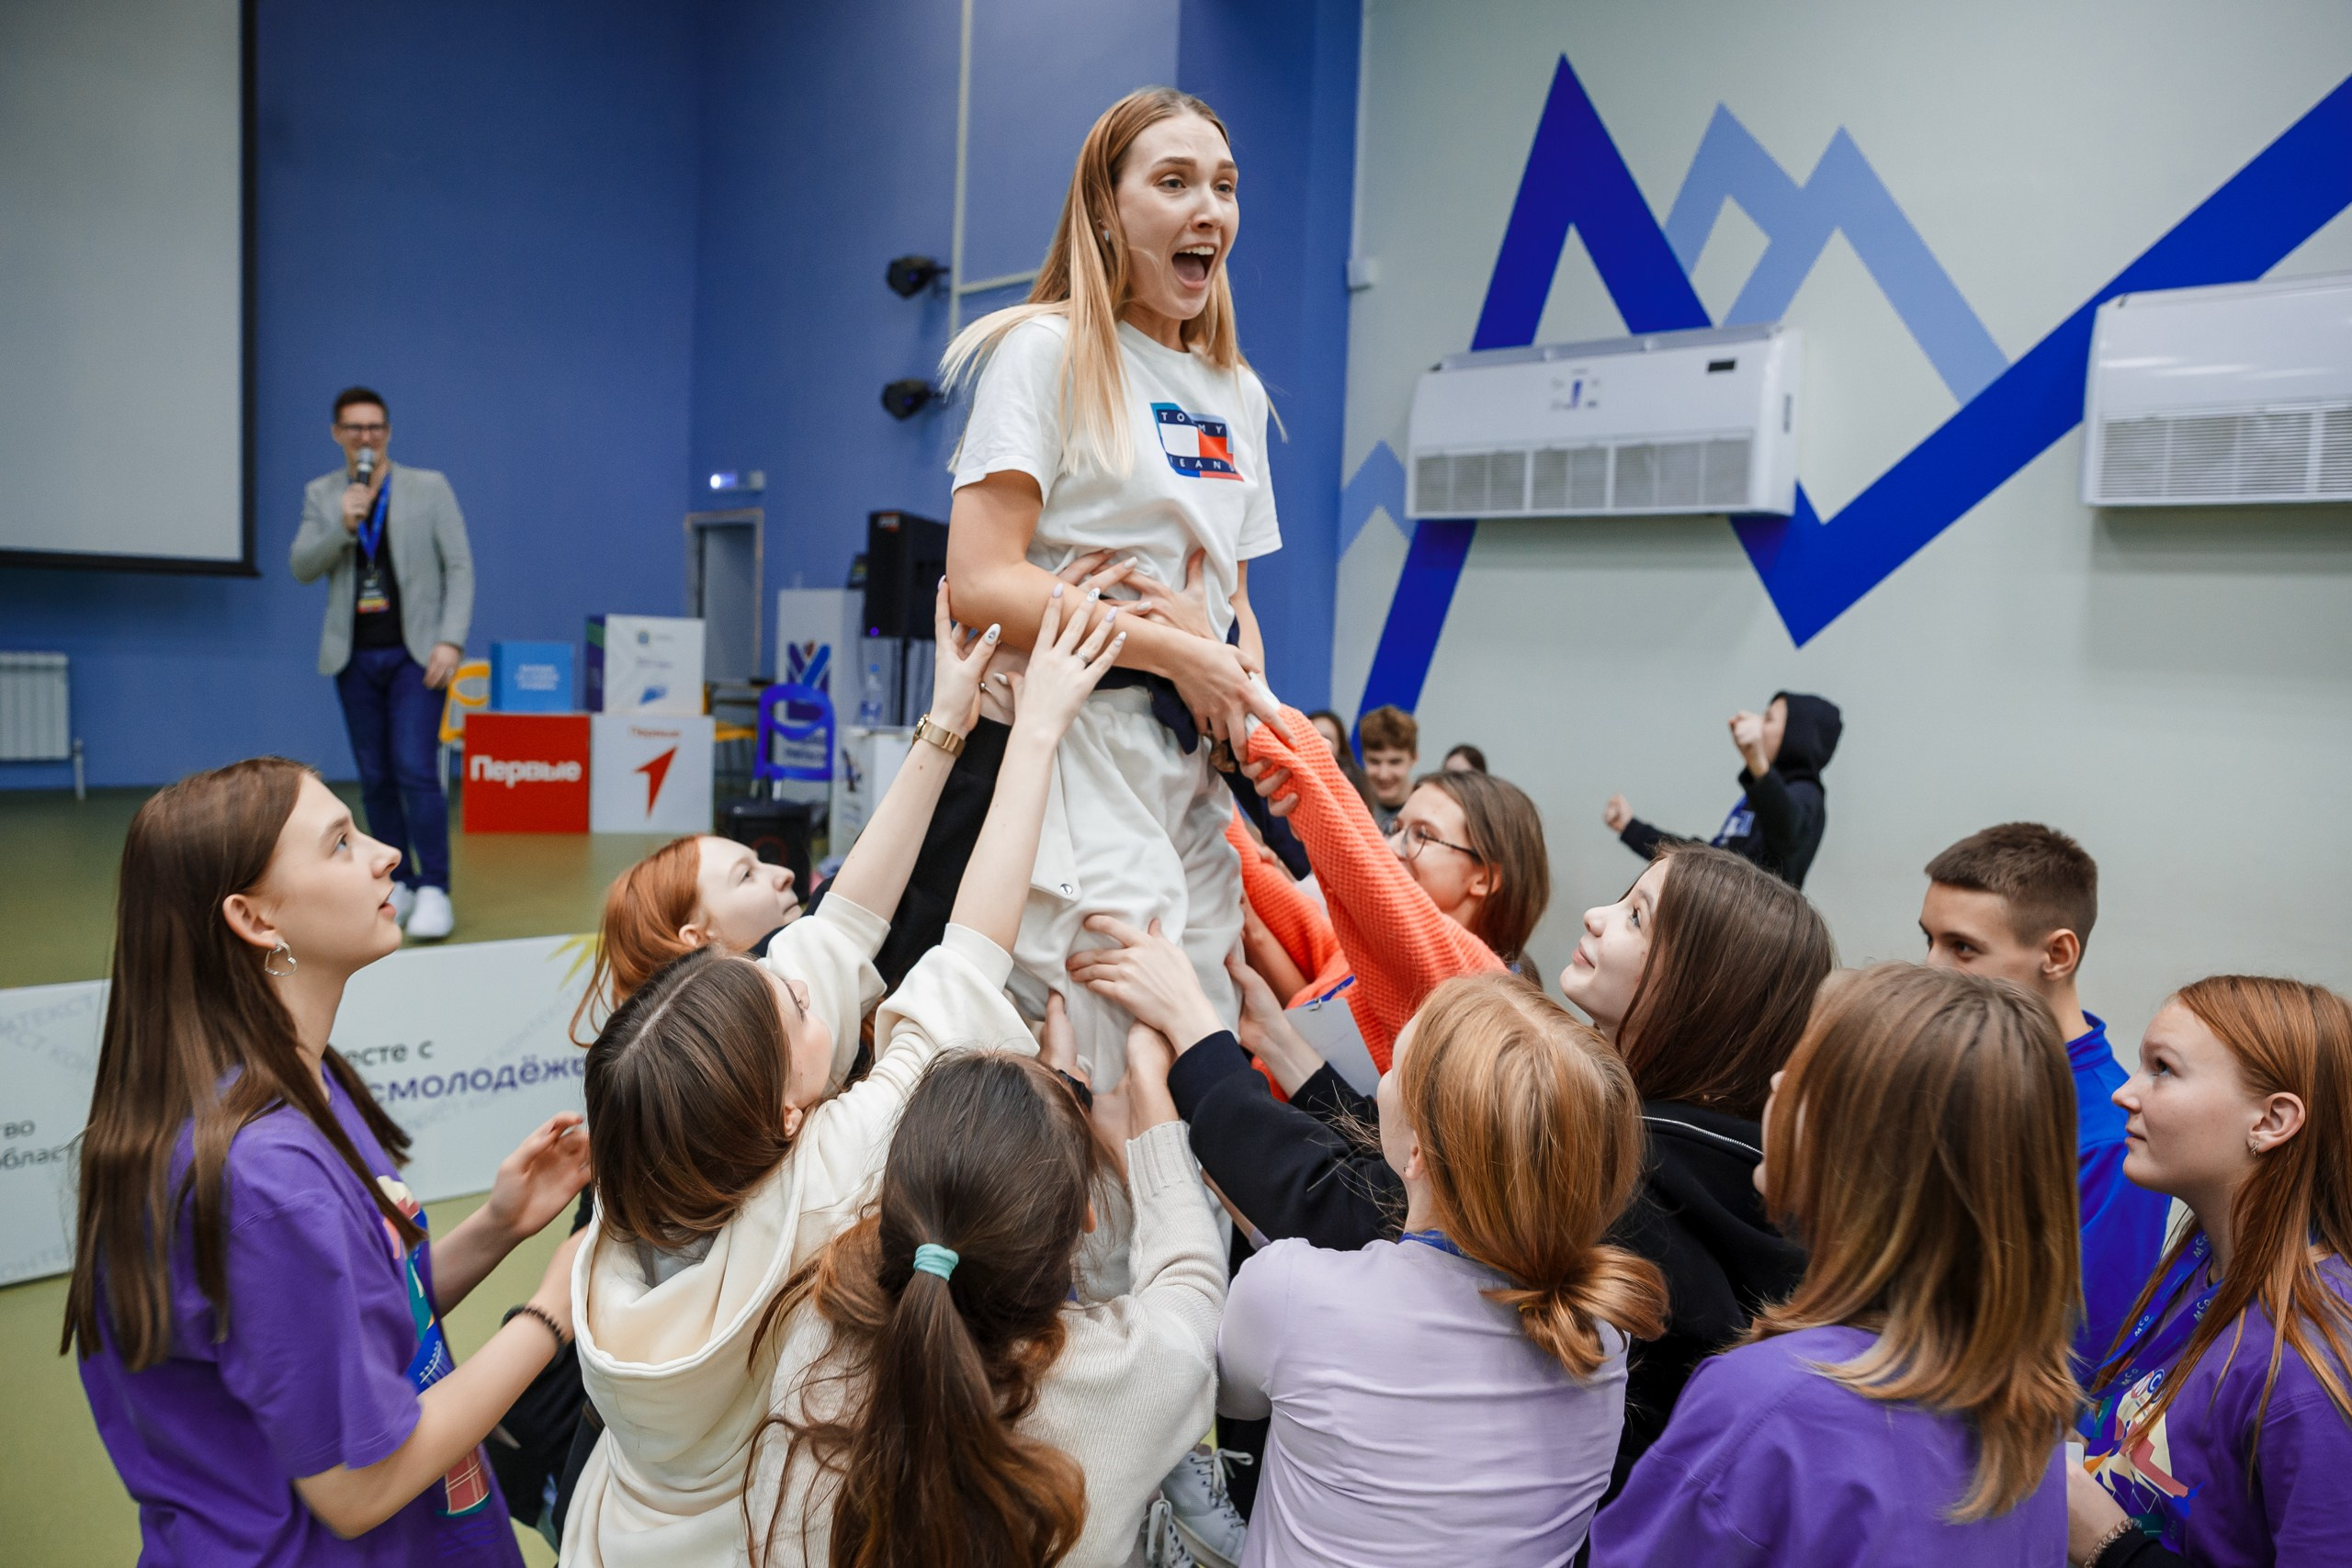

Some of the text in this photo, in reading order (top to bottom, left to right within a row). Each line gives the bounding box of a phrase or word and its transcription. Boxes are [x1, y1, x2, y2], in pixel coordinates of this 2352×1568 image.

[1160, 412, 1224, 434] TOMY
[469, 754, 582, 789] Первые
[418, 1040, 433, 1060] с
[0, 1119, 35, 1139] во
